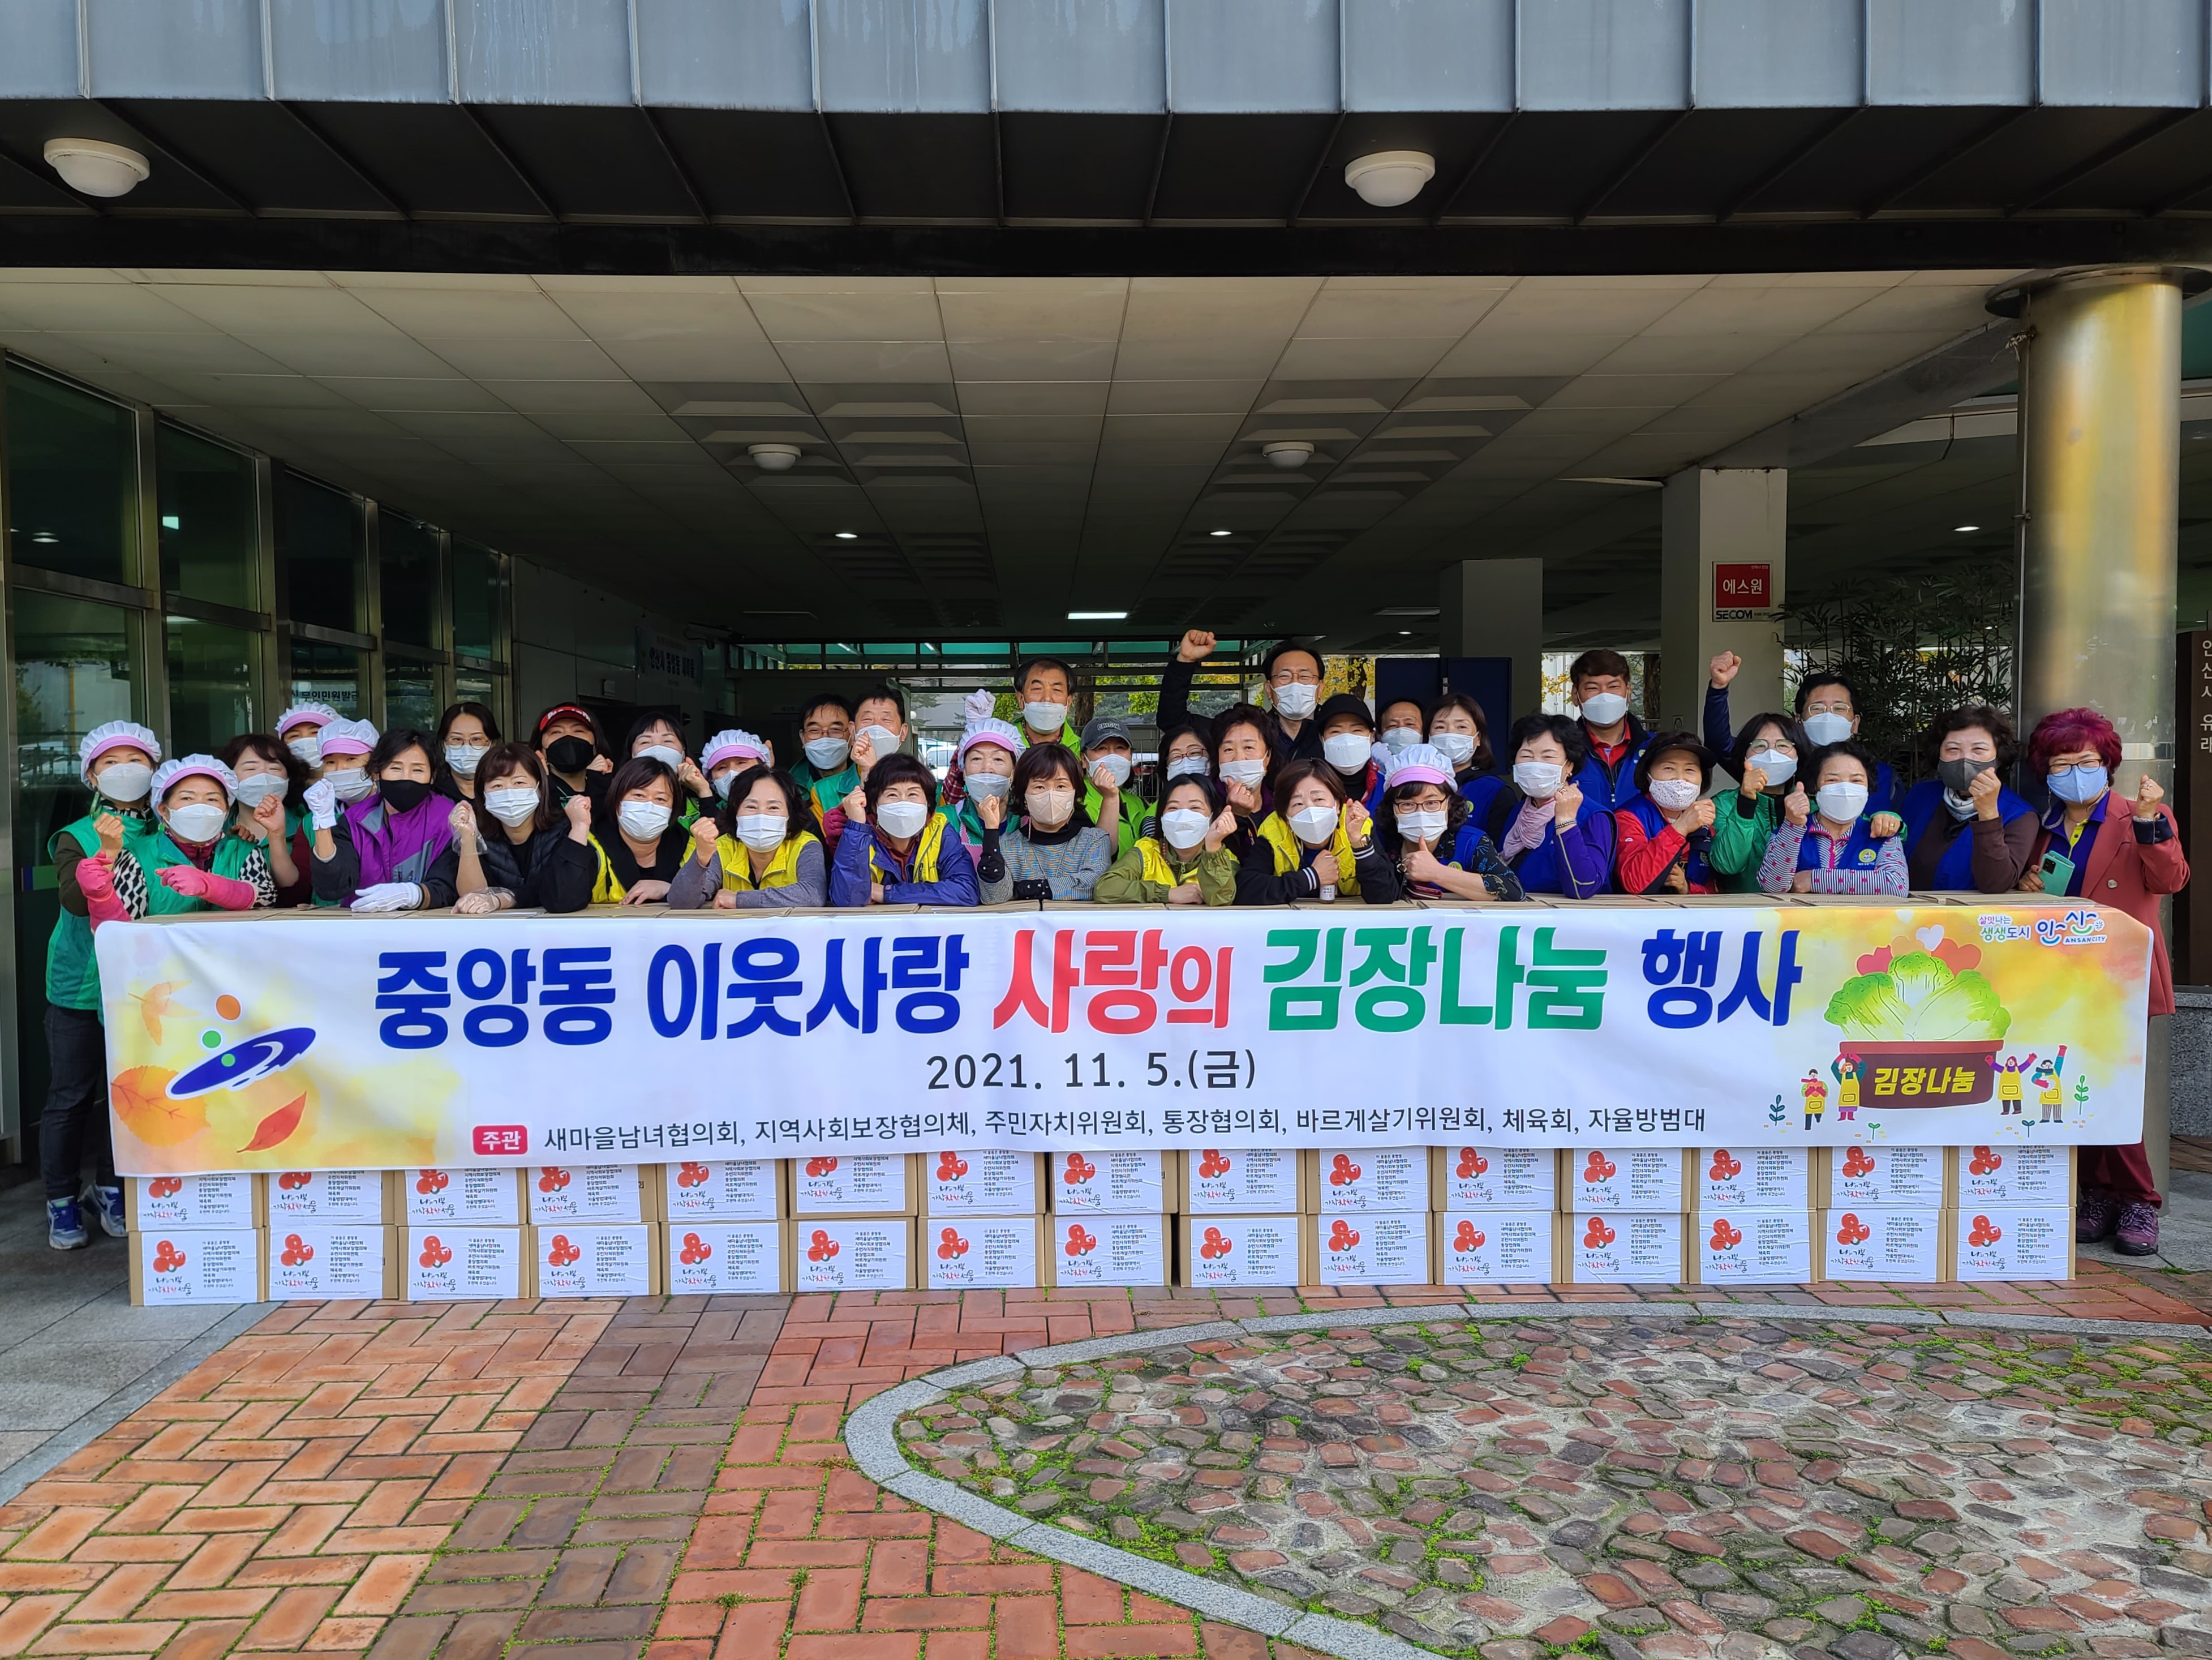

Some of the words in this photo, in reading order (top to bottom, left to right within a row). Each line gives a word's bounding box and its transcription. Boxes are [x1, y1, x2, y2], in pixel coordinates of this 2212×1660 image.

[1723, 578, 1762, 594] 에스원
[1716, 610, 1753, 619] SECOM
[1979, 916, 2011, 924] 살맛나는
[2037, 911, 2097, 944] 안산
[1981, 926, 2029, 941] 생생도시
[375, 946, 616, 1049] 중앙동
[647, 934, 969, 1040] 이웃사랑
[994, 929, 1234, 1035] 사랑의
[1263, 926, 1608, 1032] 김장나눔
[1642, 929, 1802, 1029] 행사
[926, 1053, 1042, 1089] 2021.
[1064, 1053, 1125, 1088] 11.
[1148, 1049, 1256, 1089] 5.(금)
[1875, 1067, 1975, 1095] 김장나눔
[482, 1131, 521, 1151] 주관
[544, 1121, 745, 1151] 새마을남녀협의회,
[755, 1112, 976, 1144] 지역사회보장협의체,
[984, 1109, 1153, 1135] 주민자치위원회,
[1162, 1109, 1287, 1135] 통장협의회,
[1297, 1108, 1493, 1134] 바르게살기위원회,
[1502, 1108, 1579, 1135] 체육회,
[1588, 1108, 1704, 1133] 자율방범대
